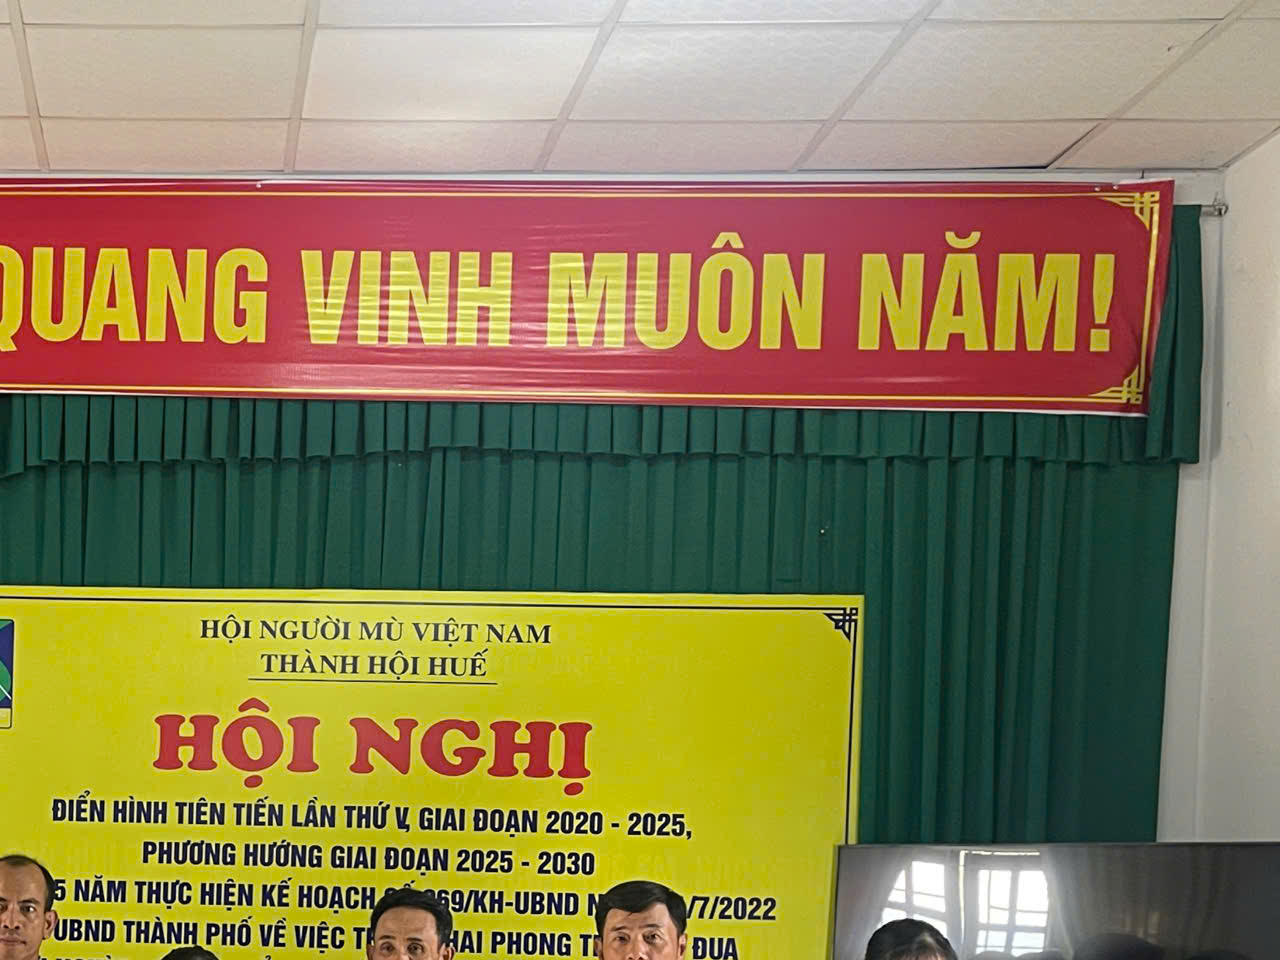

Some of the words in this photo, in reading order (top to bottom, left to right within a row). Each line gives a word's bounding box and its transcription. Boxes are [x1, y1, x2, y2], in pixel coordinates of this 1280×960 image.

[301, 250, 516, 348] VINH
[545, 232, 826, 350] MUÔN
[859, 232, 1114, 351] NĂM!
[202, 615, 250, 643] HỘI
[261, 616, 348, 639] NGƯỜI
[359, 616, 404, 642] MÙ
[411, 618, 479, 647] VIỆT
[487, 625, 550, 643] NAM
[260, 649, 360, 675] THÀNH
[369, 650, 421, 680] HỘI
[429, 649, 488, 676] HUẾ
[153, 698, 320, 787] HỘI
[350, 718, 592, 795] NGHỊ
[52, 791, 104, 822] ĐIỂN
[113, 796, 167, 823] HÌNH
[175, 798, 225, 825] TIÊN
[234, 797, 283, 826] TIẾN
[292, 797, 335, 827] LẦN
[344, 802, 390, 829] THỨ
[420, 808, 465, 831] GIAI
[473, 809, 537, 837] ĐOẠN
[546, 811, 602, 834] 2020
[628, 813, 691, 839] 2025,
[143, 840, 235, 865] PHƯƠNG
[244, 840, 322, 867] HƯỚNG
[331, 846, 376, 869] GIAI
[385, 847, 448, 875] ĐOẠN
[457, 850, 512, 873] 2025
[538, 852, 594, 875] 2030
[74, 875, 126, 902] NĂM
[135, 880, 192, 909] THỰC
[201, 879, 253, 910] HIỆN
[262, 878, 292, 907] KẾ
[298, 884, 376, 914] HOẠCH
[54, 918, 116, 943] UBND
[123, 916, 198, 945] THÀNH
[206, 915, 253, 947] PHỐ
[260, 918, 286, 947] VỀ
[295, 921, 344, 953] VIỆC
[491, 932, 571, 956] PHONG
[692, 937, 738, 960] ĐUA
